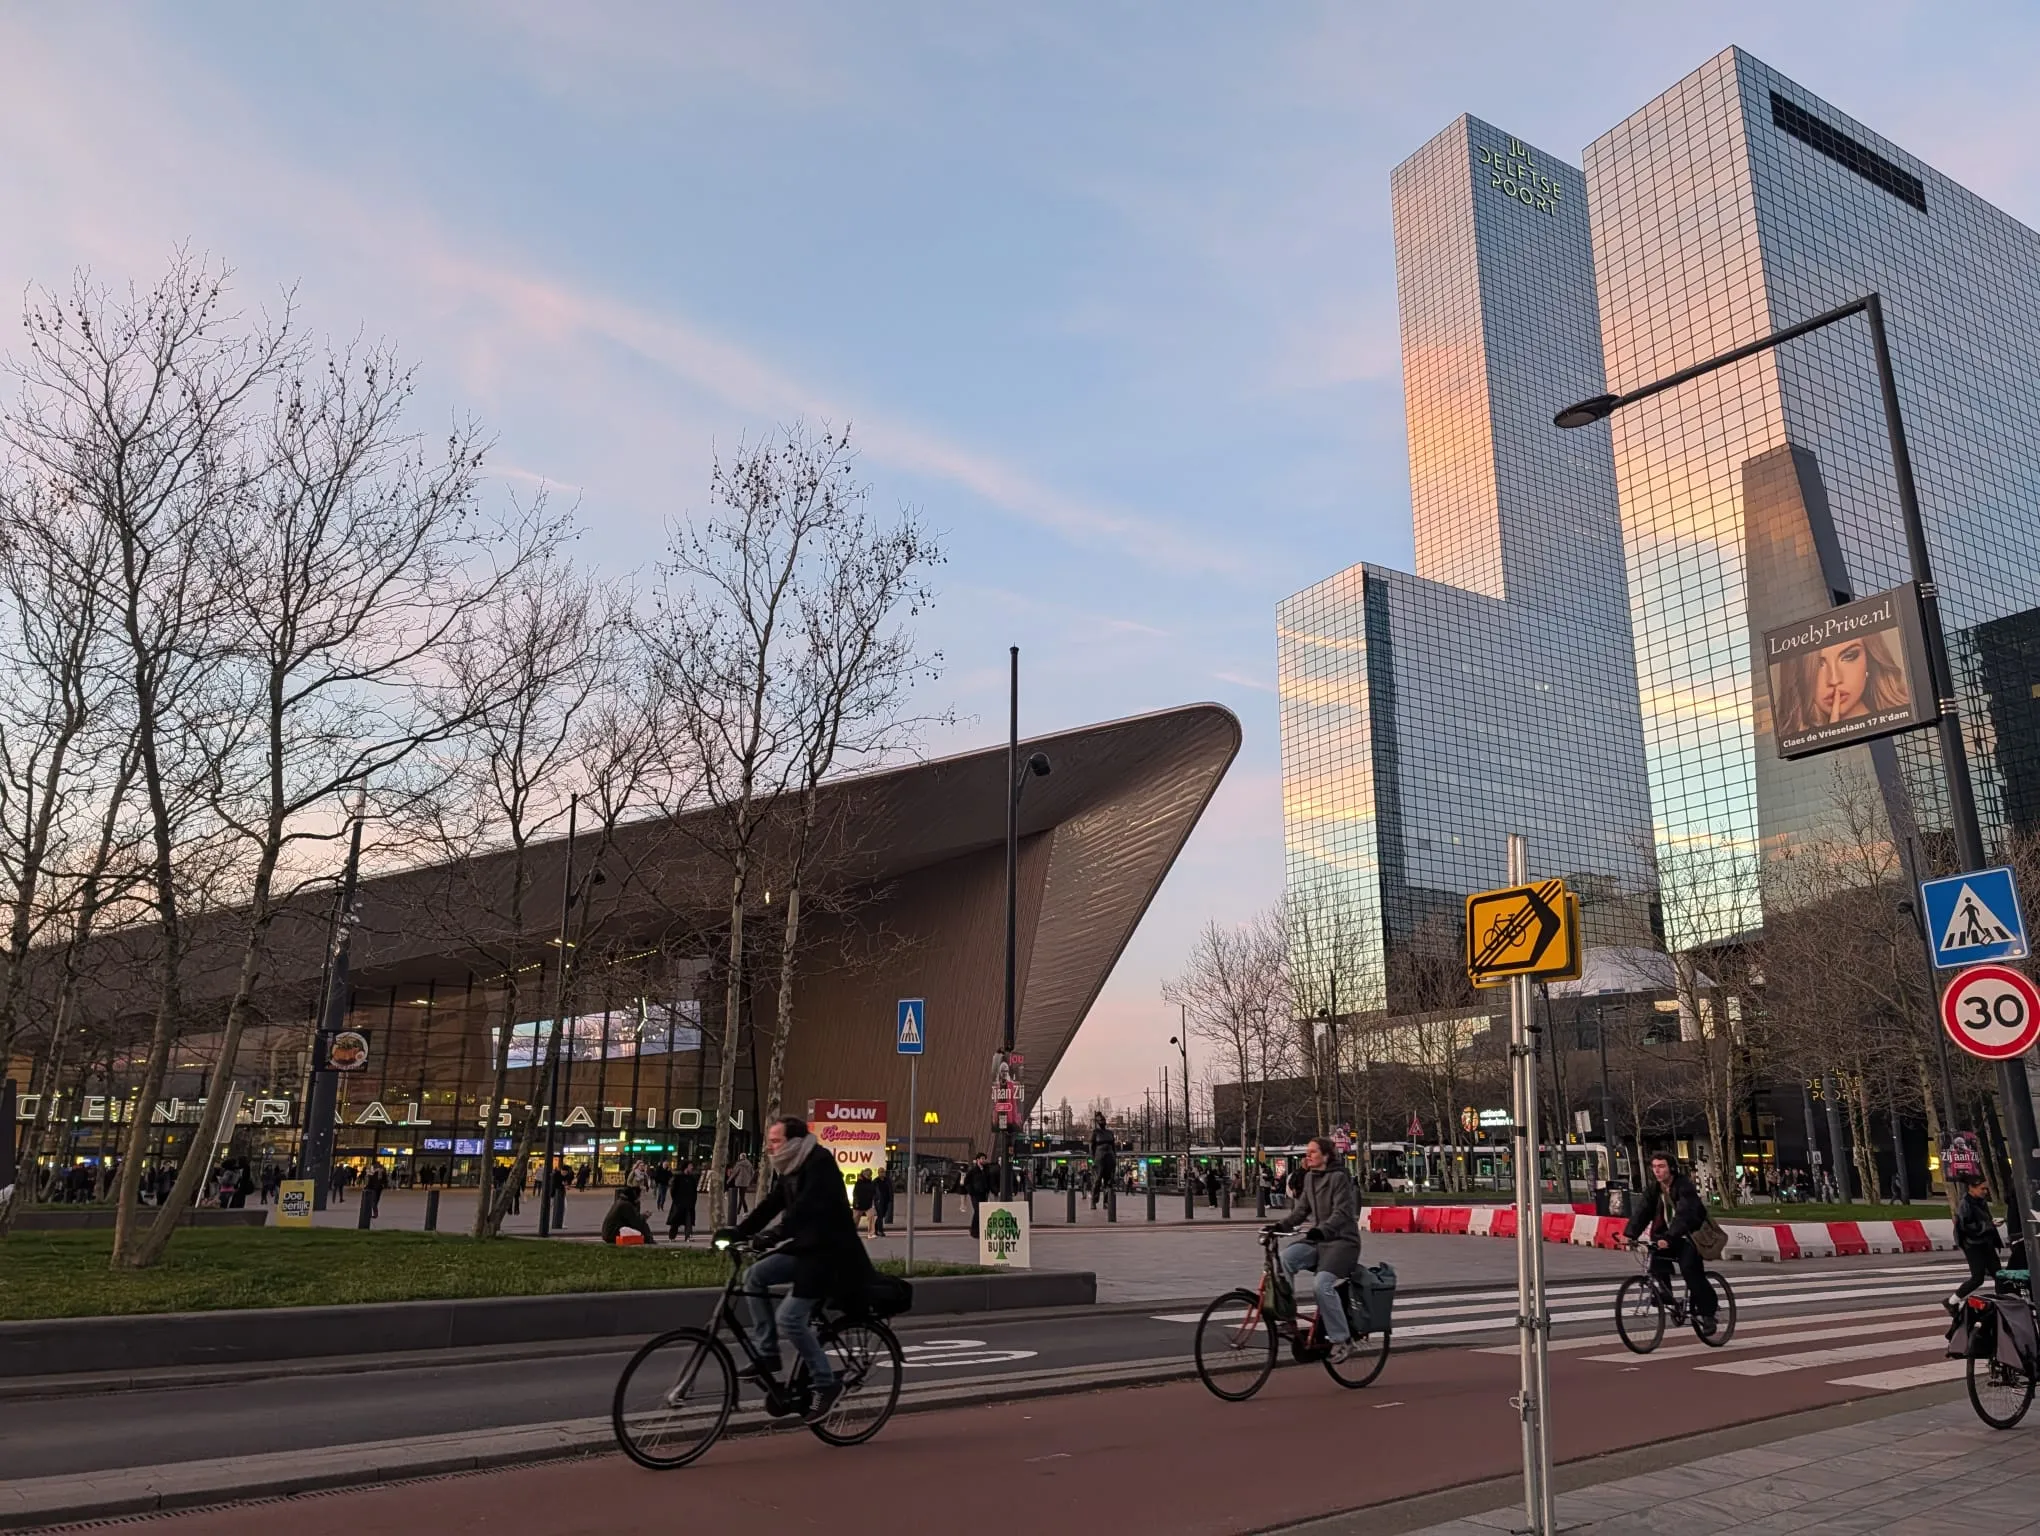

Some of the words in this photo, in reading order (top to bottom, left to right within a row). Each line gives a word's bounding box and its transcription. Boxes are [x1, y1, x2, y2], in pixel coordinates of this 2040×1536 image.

[1479, 145, 1562, 200] DELFTSE
[1491, 172, 1556, 216] POORT
[1769, 600, 1892, 655] LovelyPrive.nl
[1783, 736, 1806, 748] Claes
[1807, 733, 1818, 742] de
[1818, 721, 1866, 739] Vrieselaan
[1867, 717, 1878, 726] 17
[1879, 710, 1910, 724] R'dam
[1963, 994, 2025, 1030] 30
[1013, 1084, 1025, 1102] Zij
[16, 1094, 431, 1126] CENRAL
[826, 1103, 877, 1120] Jouw
[820, 1125, 881, 1142] Rotterdam
[284, 1192, 303, 1200] Doe
[984, 1229, 992, 1241] IN
[993, 1229, 1021, 1241] JOUW
[987, 1217, 1018, 1228] GROEN
